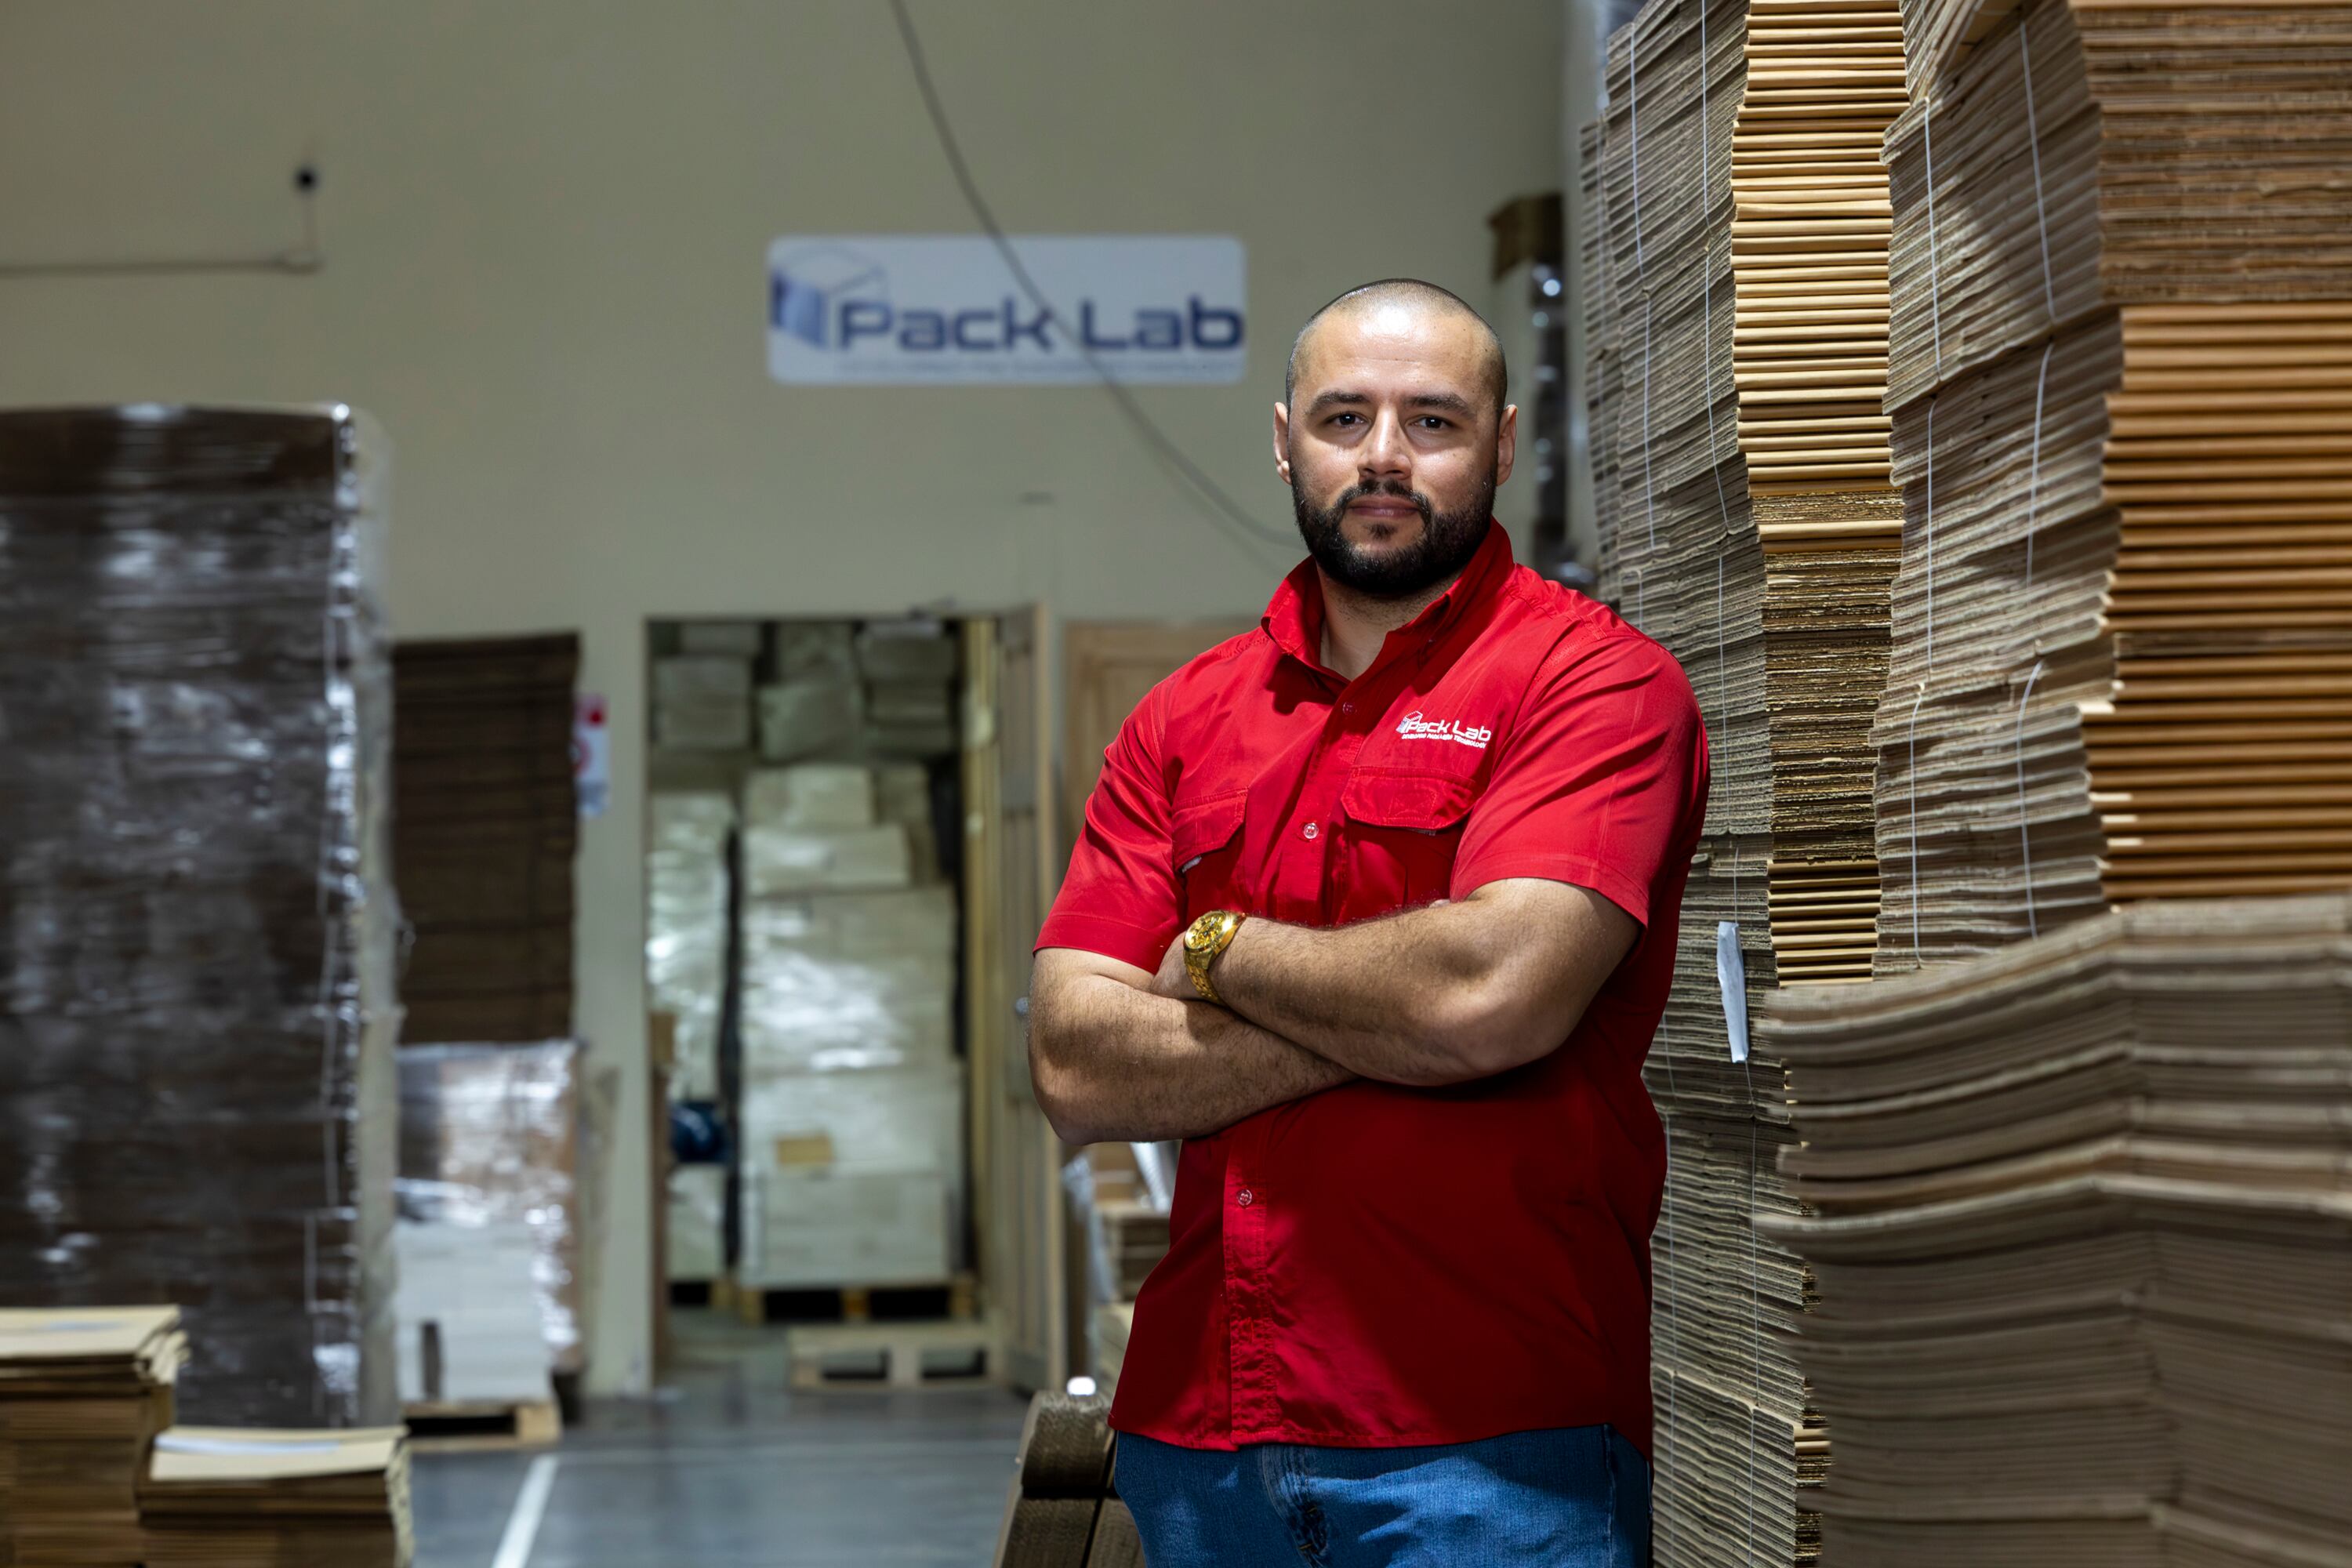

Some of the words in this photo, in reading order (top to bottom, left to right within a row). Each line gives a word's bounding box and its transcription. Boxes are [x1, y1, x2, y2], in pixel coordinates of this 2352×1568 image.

[838, 295, 1054, 352] Pack
[1080, 293, 1244, 352] Lab
[1405, 720, 1451, 733] Pack
[1452, 720, 1491, 742] Lab
